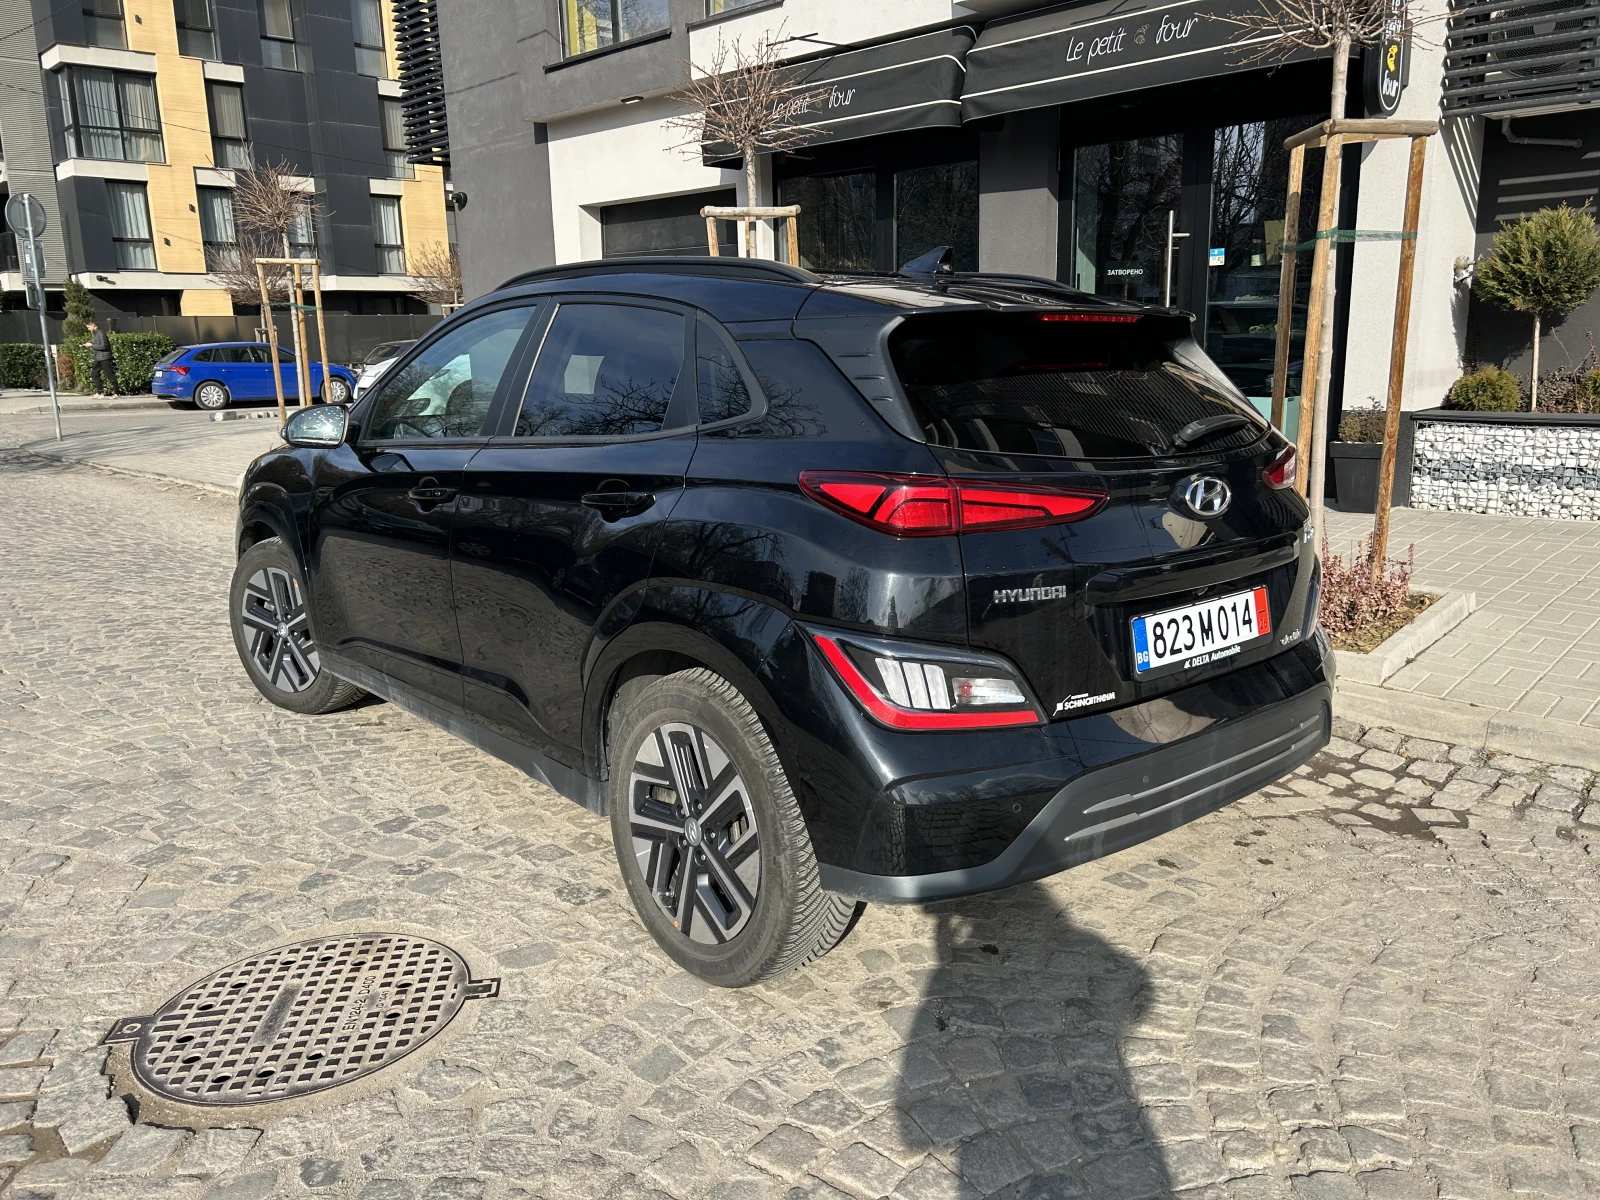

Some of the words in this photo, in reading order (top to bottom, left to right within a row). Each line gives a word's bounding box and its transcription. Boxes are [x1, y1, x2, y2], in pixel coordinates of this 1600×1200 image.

[1066, 37, 1084, 61] Le
[1087, 27, 1127, 65] petit
[1155, 14, 1199, 45] four
[1382, 69, 1399, 97] four
[828, 85, 856, 109] four
[1107, 268, 1144, 276] ЗАТВОРЕНО
[993, 585, 1067, 604] HYUNDAI
[1137, 652, 1149, 664] BG
[1191, 655, 1210, 668] DELTA
[1210, 645, 1242, 661] Automobile
[357, 975, 377, 995] D400
